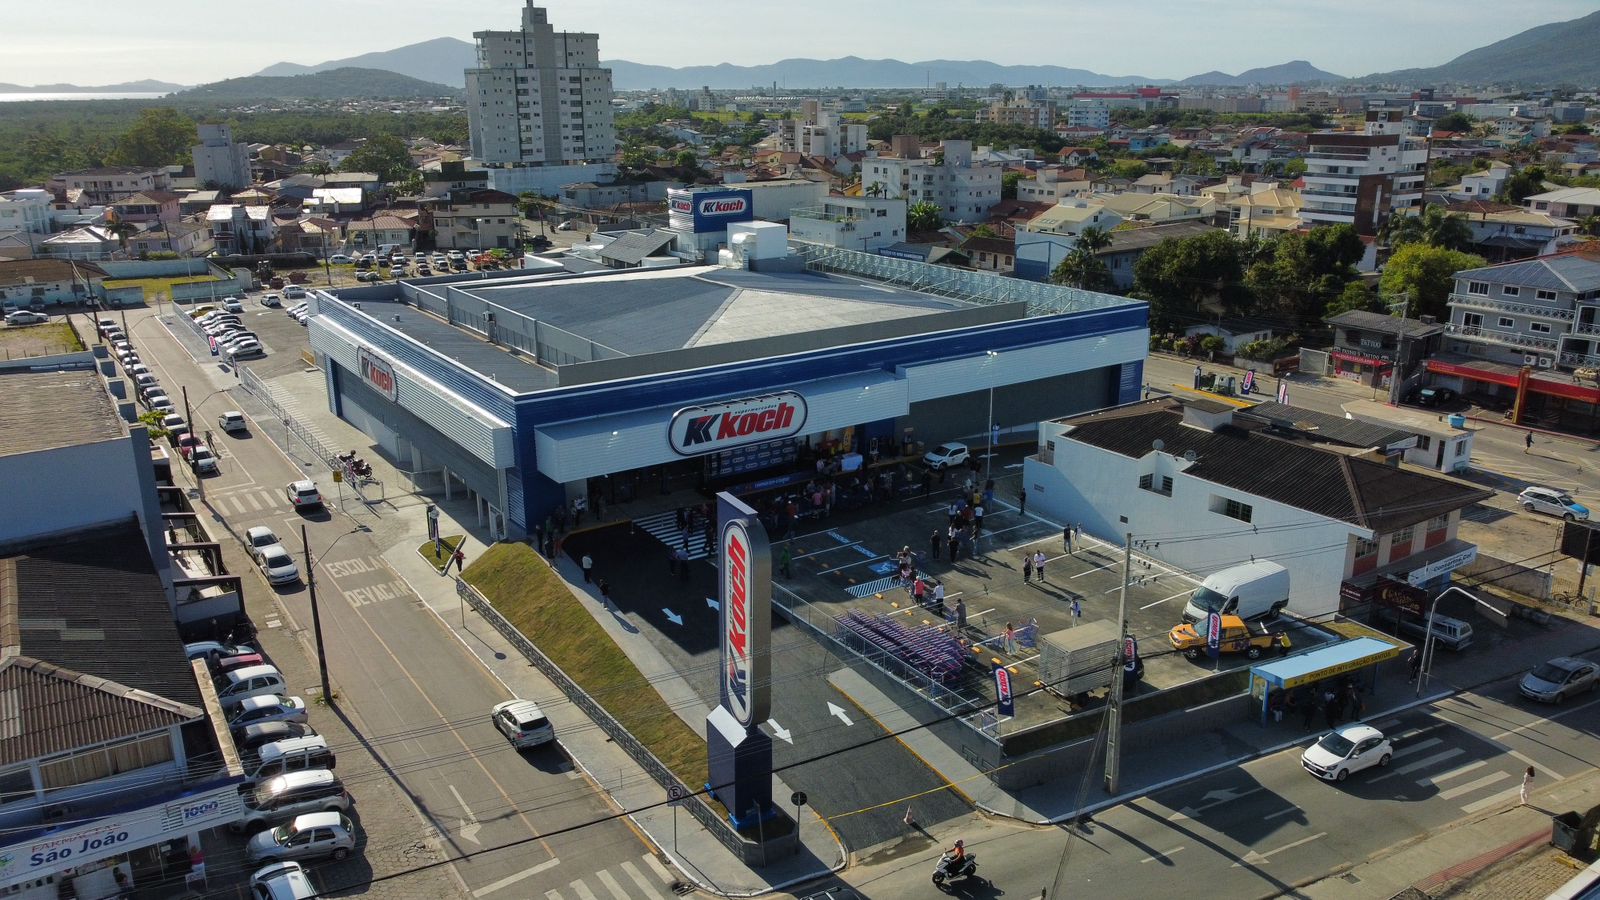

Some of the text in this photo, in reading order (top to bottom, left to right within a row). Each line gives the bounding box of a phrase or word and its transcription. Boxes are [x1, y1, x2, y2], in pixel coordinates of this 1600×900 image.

[325, 555, 385, 578] ESCOLA
[29, 830, 129, 867] São João
